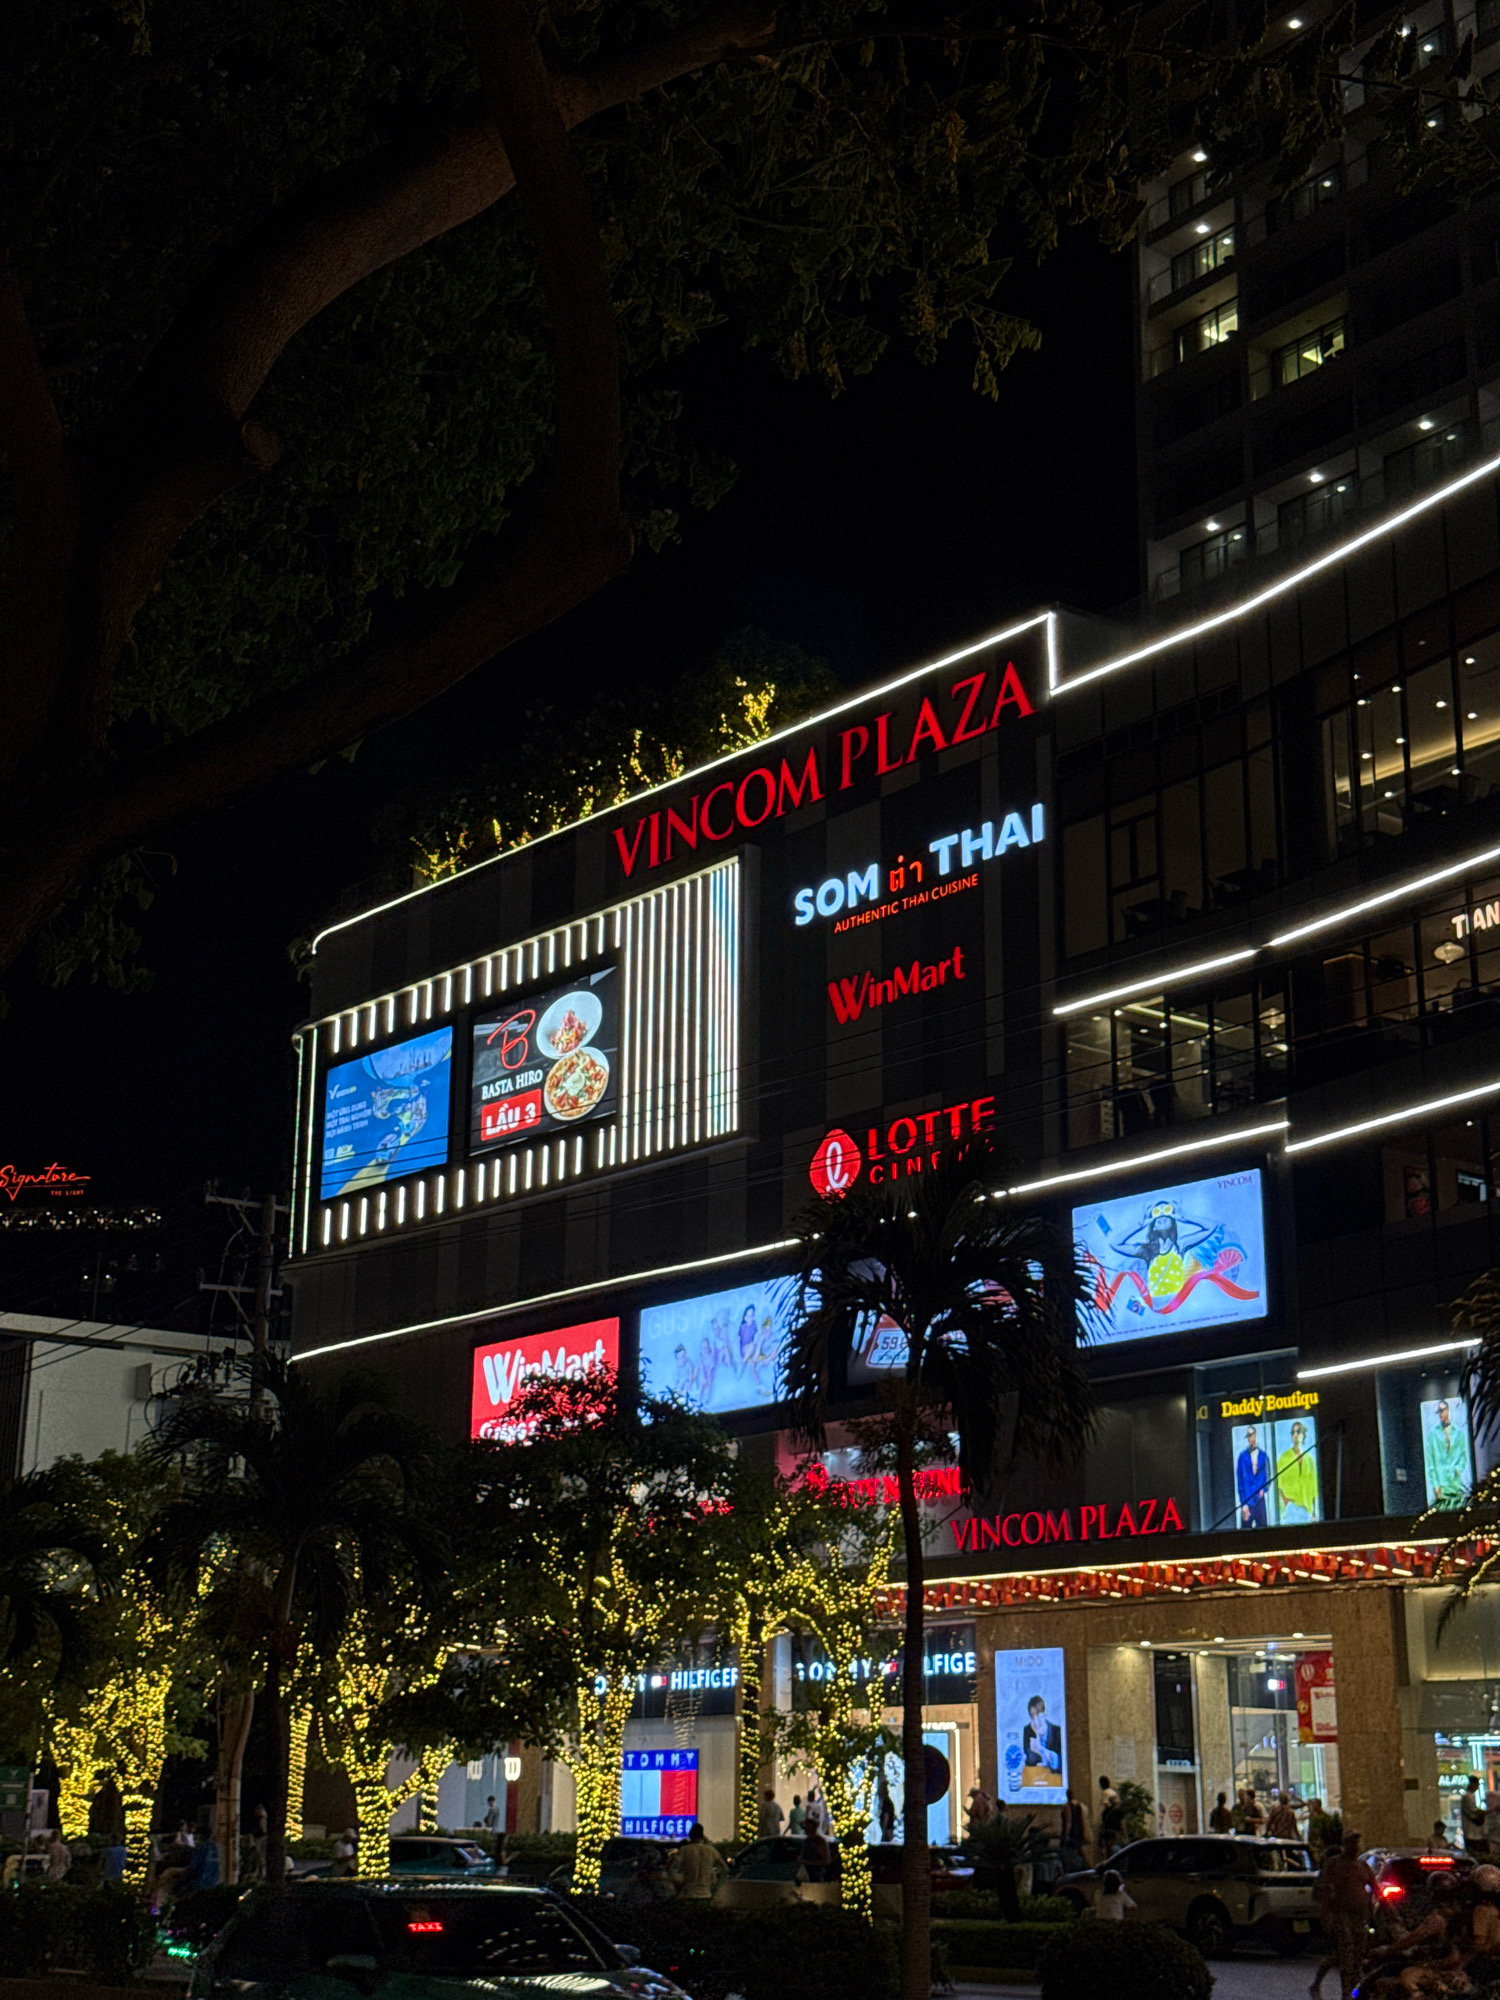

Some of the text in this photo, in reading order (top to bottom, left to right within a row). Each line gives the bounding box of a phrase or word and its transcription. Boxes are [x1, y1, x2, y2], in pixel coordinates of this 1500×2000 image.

[612, 660, 1037, 878] VINCOM PLAZA
[794, 863, 879, 926] SOM
[929, 803, 1044, 876] THAI
[834, 873, 979, 934] AUTHENTIC THAI CUISINE
[828, 946, 966, 1025] WinMart
[481, 1069, 543, 1100] BASTA HIRO
[486, 1102, 537, 1136] LẦU 3
[868, 1096, 995, 1161] LOTTE
[869, 1138, 994, 1184] CIN
[0, 1162, 91, 1201] Signature
[1217, 1175, 1252, 1190] VINCOM
[1221, 1397, 1264, 1417] Daddy
[1265, 1390, 1319, 1411] Boutiqu
[950, 1497, 1184, 1552] VINCOM PLAZA
[923, 1651, 976, 1676] LFIGE
[1015, 1656, 1043, 1667] MIDO
[626, 1752, 695, 1767] TOMMY
[624, 1819, 693, 1835] HILFIGER
[408, 1921, 443, 1932] TAXI
